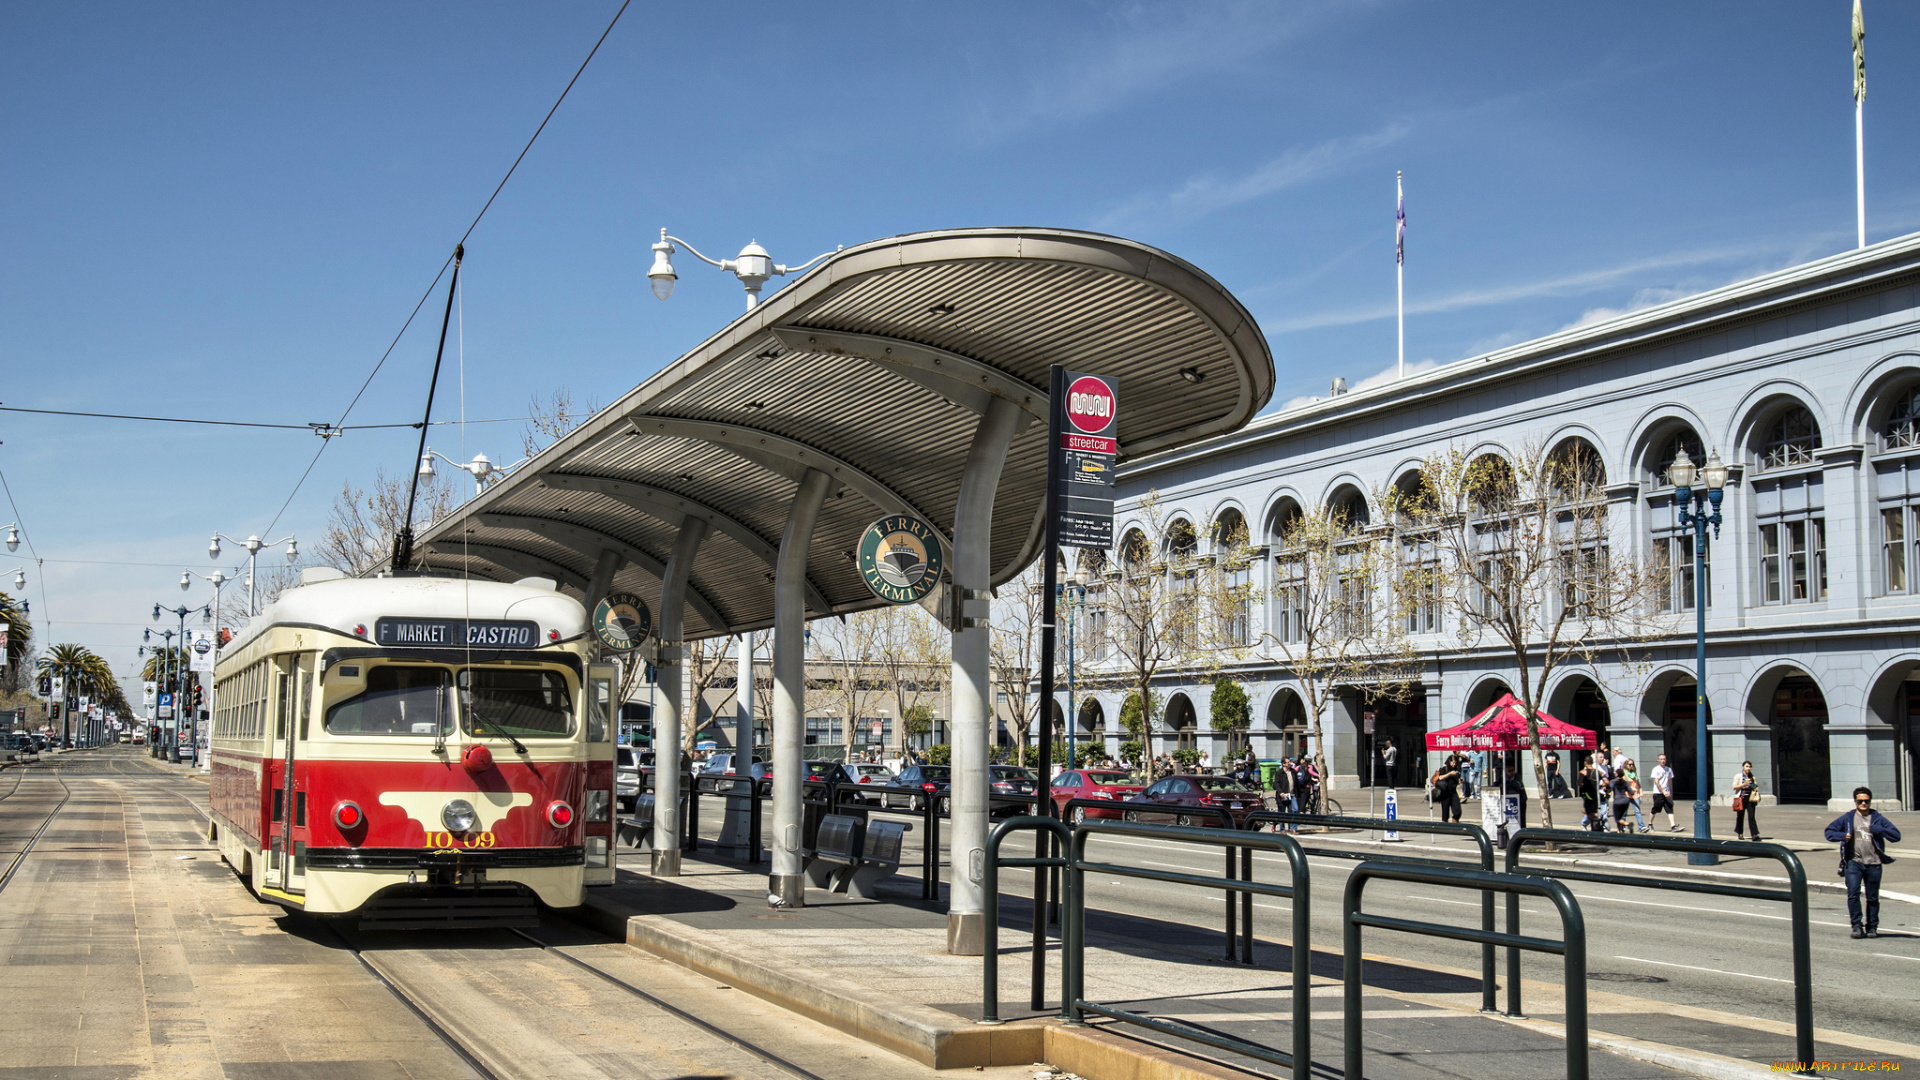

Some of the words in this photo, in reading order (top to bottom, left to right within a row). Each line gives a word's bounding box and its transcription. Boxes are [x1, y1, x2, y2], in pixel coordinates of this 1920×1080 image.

[1069, 437, 1108, 450] streetcar
[1065, 451, 1072, 464] F
[874, 518, 933, 540] FERRY
[865, 564, 939, 600] TERMINAL
[604, 595, 644, 609] FERRY
[380, 623, 388, 641] F
[397, 624, 446, 642] MARKET
[466, 626, 530, 644] CASTRO
[598, 625, 648, 649] TERMINAL
[1436, 735, 1449, 748] Ferry
[1451, 735, 1471, 748] Building
[1473, 735, 1493, 748] Parking
[1517, 734, 1530, 746] Ferr
[1540, 734, 1559, 747] uilding
[1561, 734, 1585, 747] Parking
